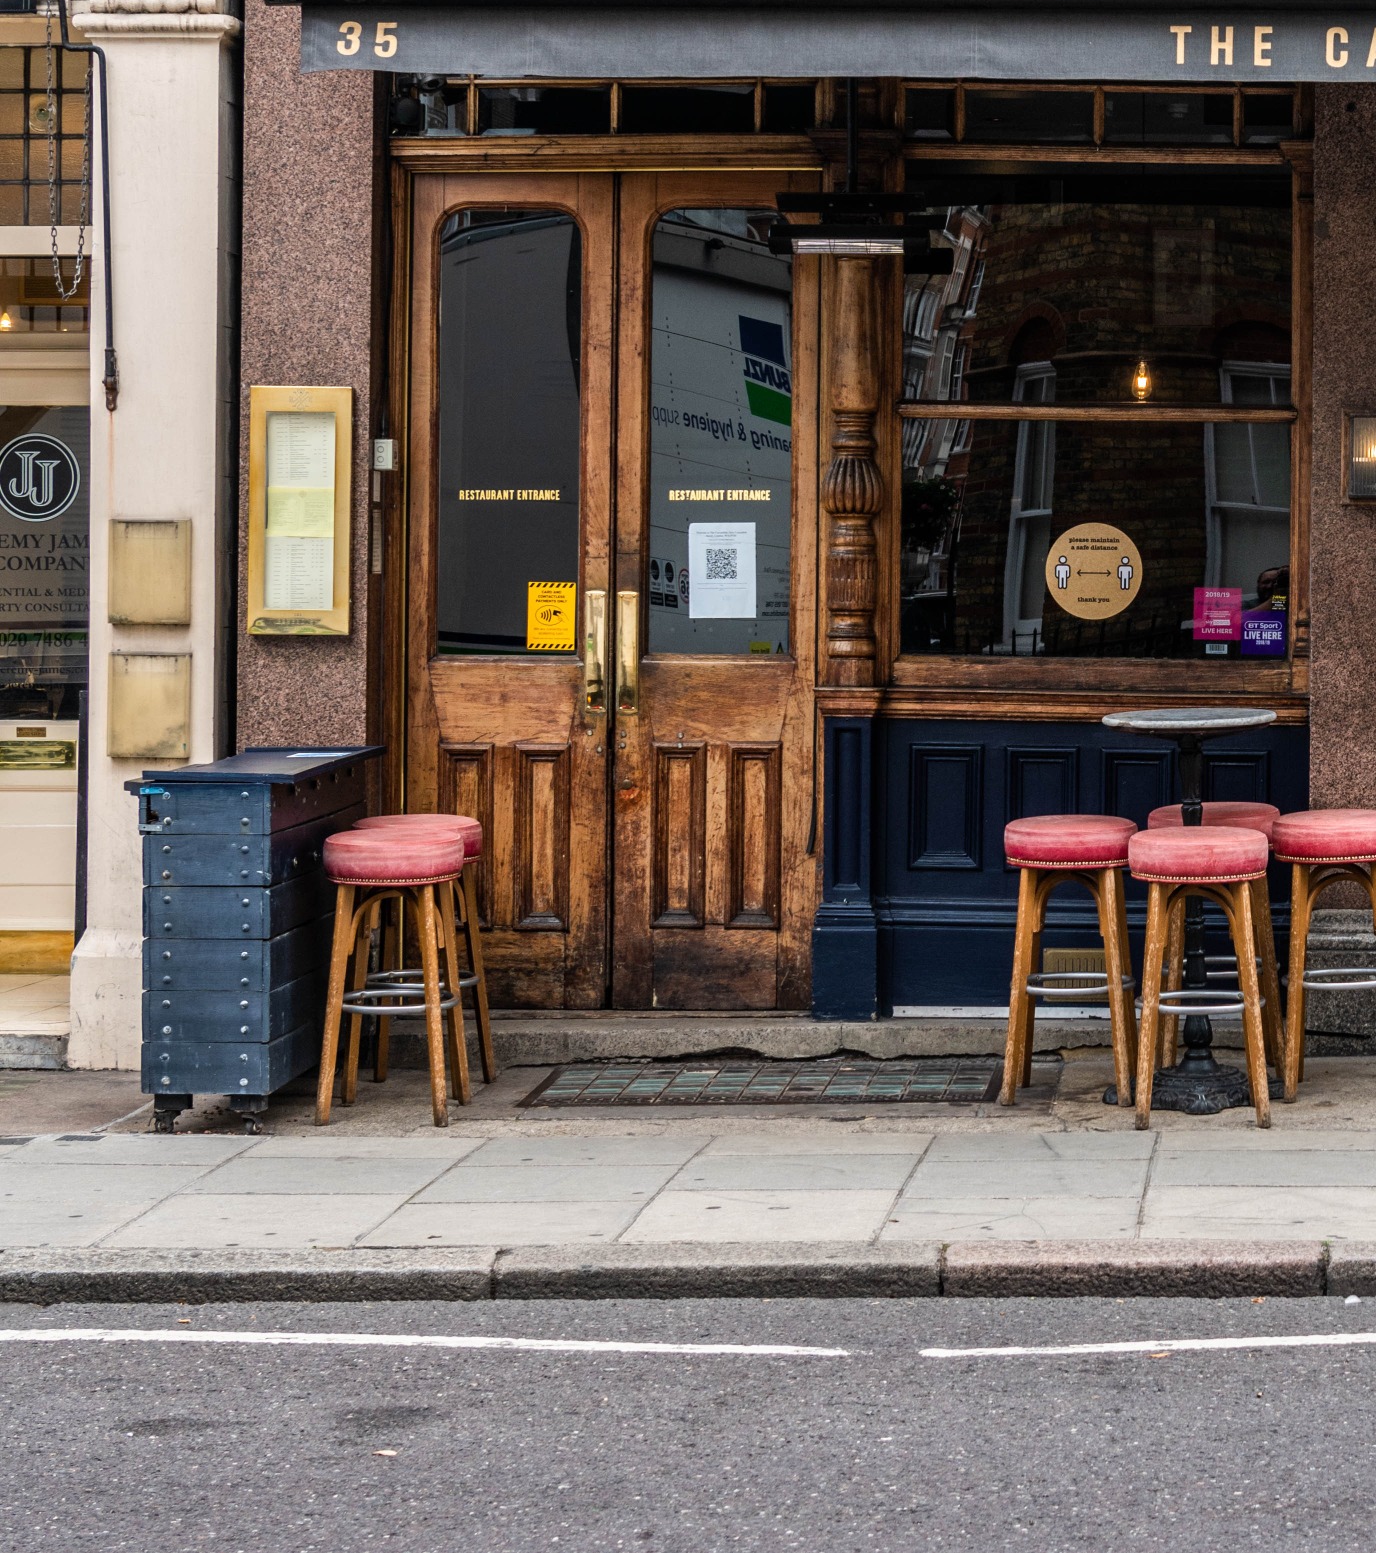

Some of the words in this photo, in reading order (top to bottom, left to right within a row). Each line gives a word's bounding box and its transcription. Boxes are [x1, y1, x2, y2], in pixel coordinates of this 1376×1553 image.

[336, 21, 400, 58] 35
[1169, 25, 1274, 67] THE
[459, 489, 515, 501] RESTAURANT
[517, 489, 561, 501] ENTRANCE
[669, 489, 724, 501] RESTAURANT
[726, 489, 771, 501] ENTRANCE
[45, 588, 53, 596] &
[1260, 622, 1279, 630] Sport
[0, 632, 27, 647] 020
[33, 632, 73, 647] 7486
[1244, 631, 1261, 640] LIVE
[1262, 631, 1283, 640] HERE
